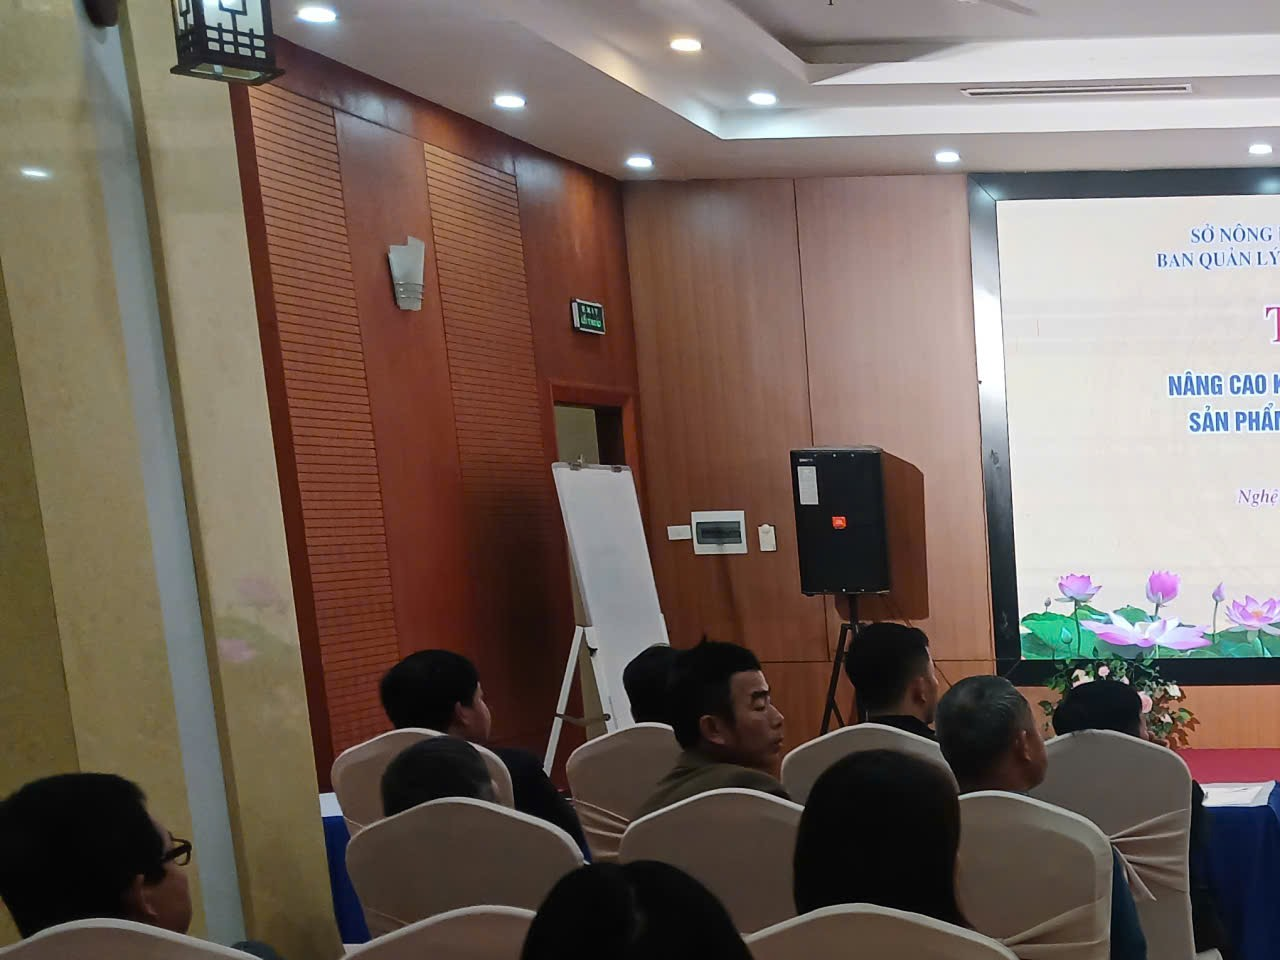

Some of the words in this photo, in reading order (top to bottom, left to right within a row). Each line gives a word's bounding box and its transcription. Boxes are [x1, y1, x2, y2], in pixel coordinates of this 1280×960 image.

[1190, 224, 1214, 243] SỞ
[1220, 224, 1272, 242] NÔNG
[1157, 252, 1194, 268] BAN
[1199, 247, 1251, 270] QUẢN
[1257, 246, 1280, 266] LÝ
[581, 305, 598, 316] EXIT
[1168, 371, 1223, 396] NÂNG
[1229, 374, 1267, 395] CAO
[1189, 405, 1229, 432] SẢN
[1238, 488, 1279, 507] Nghệ
